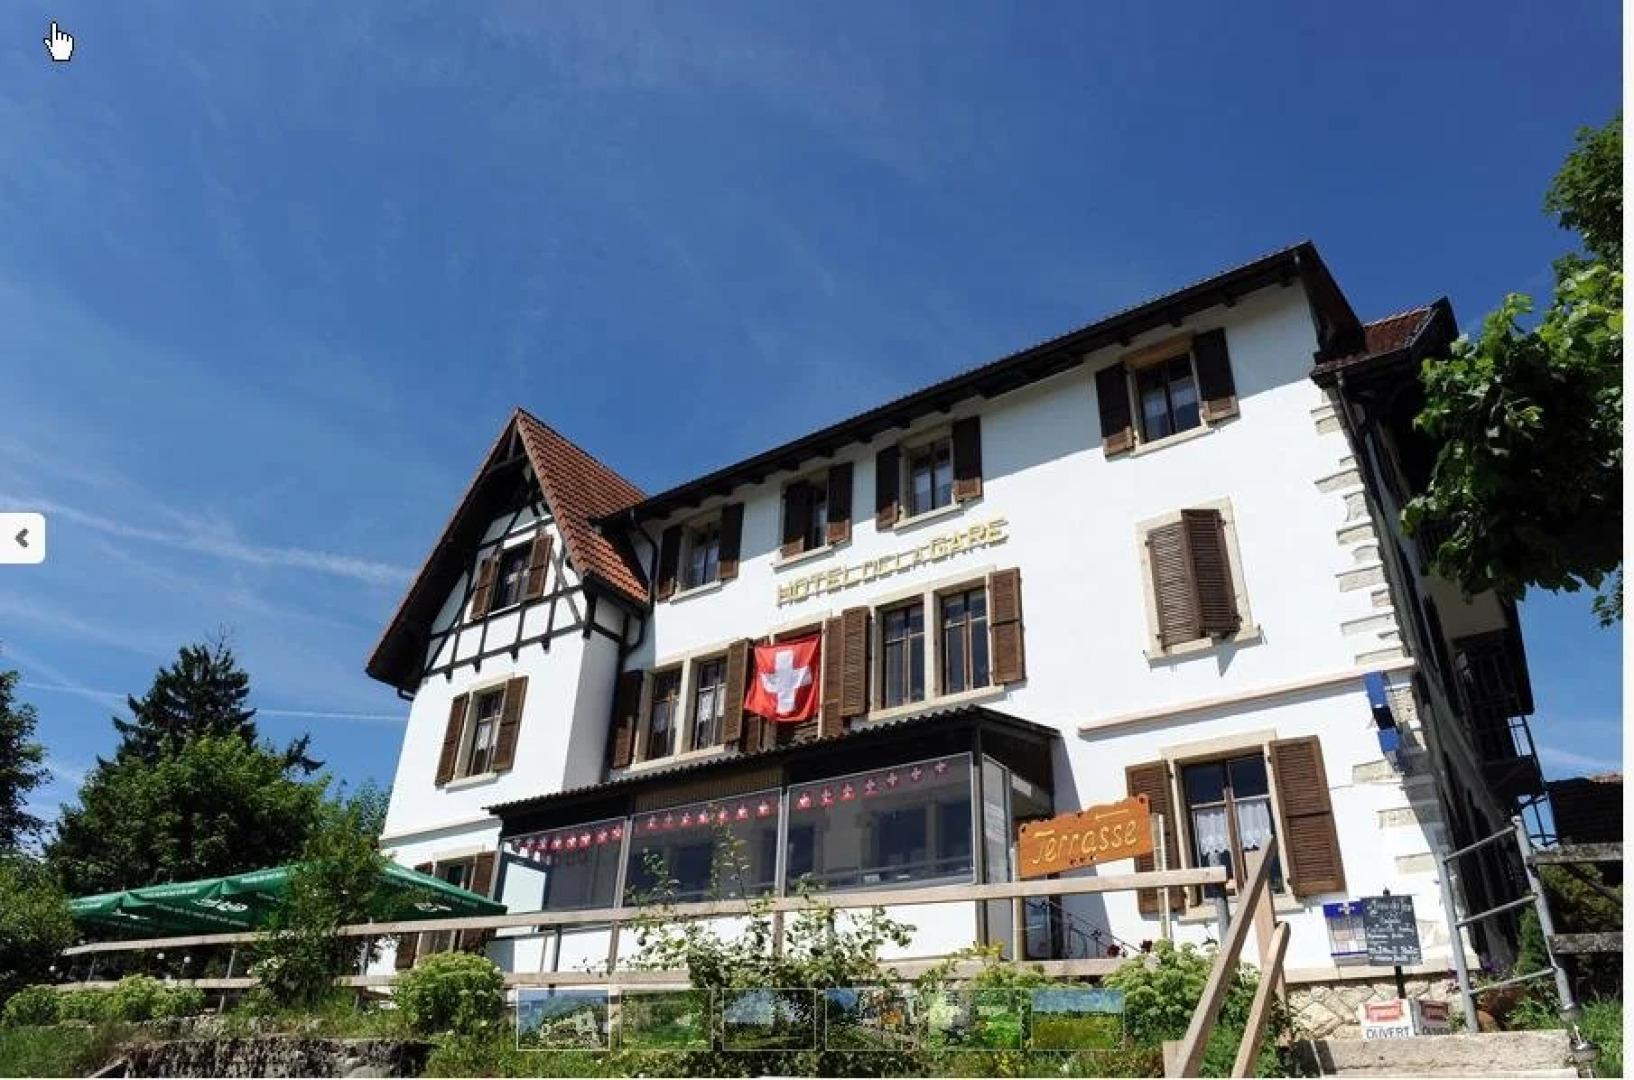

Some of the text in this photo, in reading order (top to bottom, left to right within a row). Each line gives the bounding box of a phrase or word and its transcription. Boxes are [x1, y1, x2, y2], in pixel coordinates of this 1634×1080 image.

[777, 563, 862, 606] HOTEL
[862, 554, 896, 584] DE
[929, 518, 1010, 564] GARE
[1032, 810, 1137, 864] Terrasse
[1366, 1026, 1409, 1039] OUVERT
